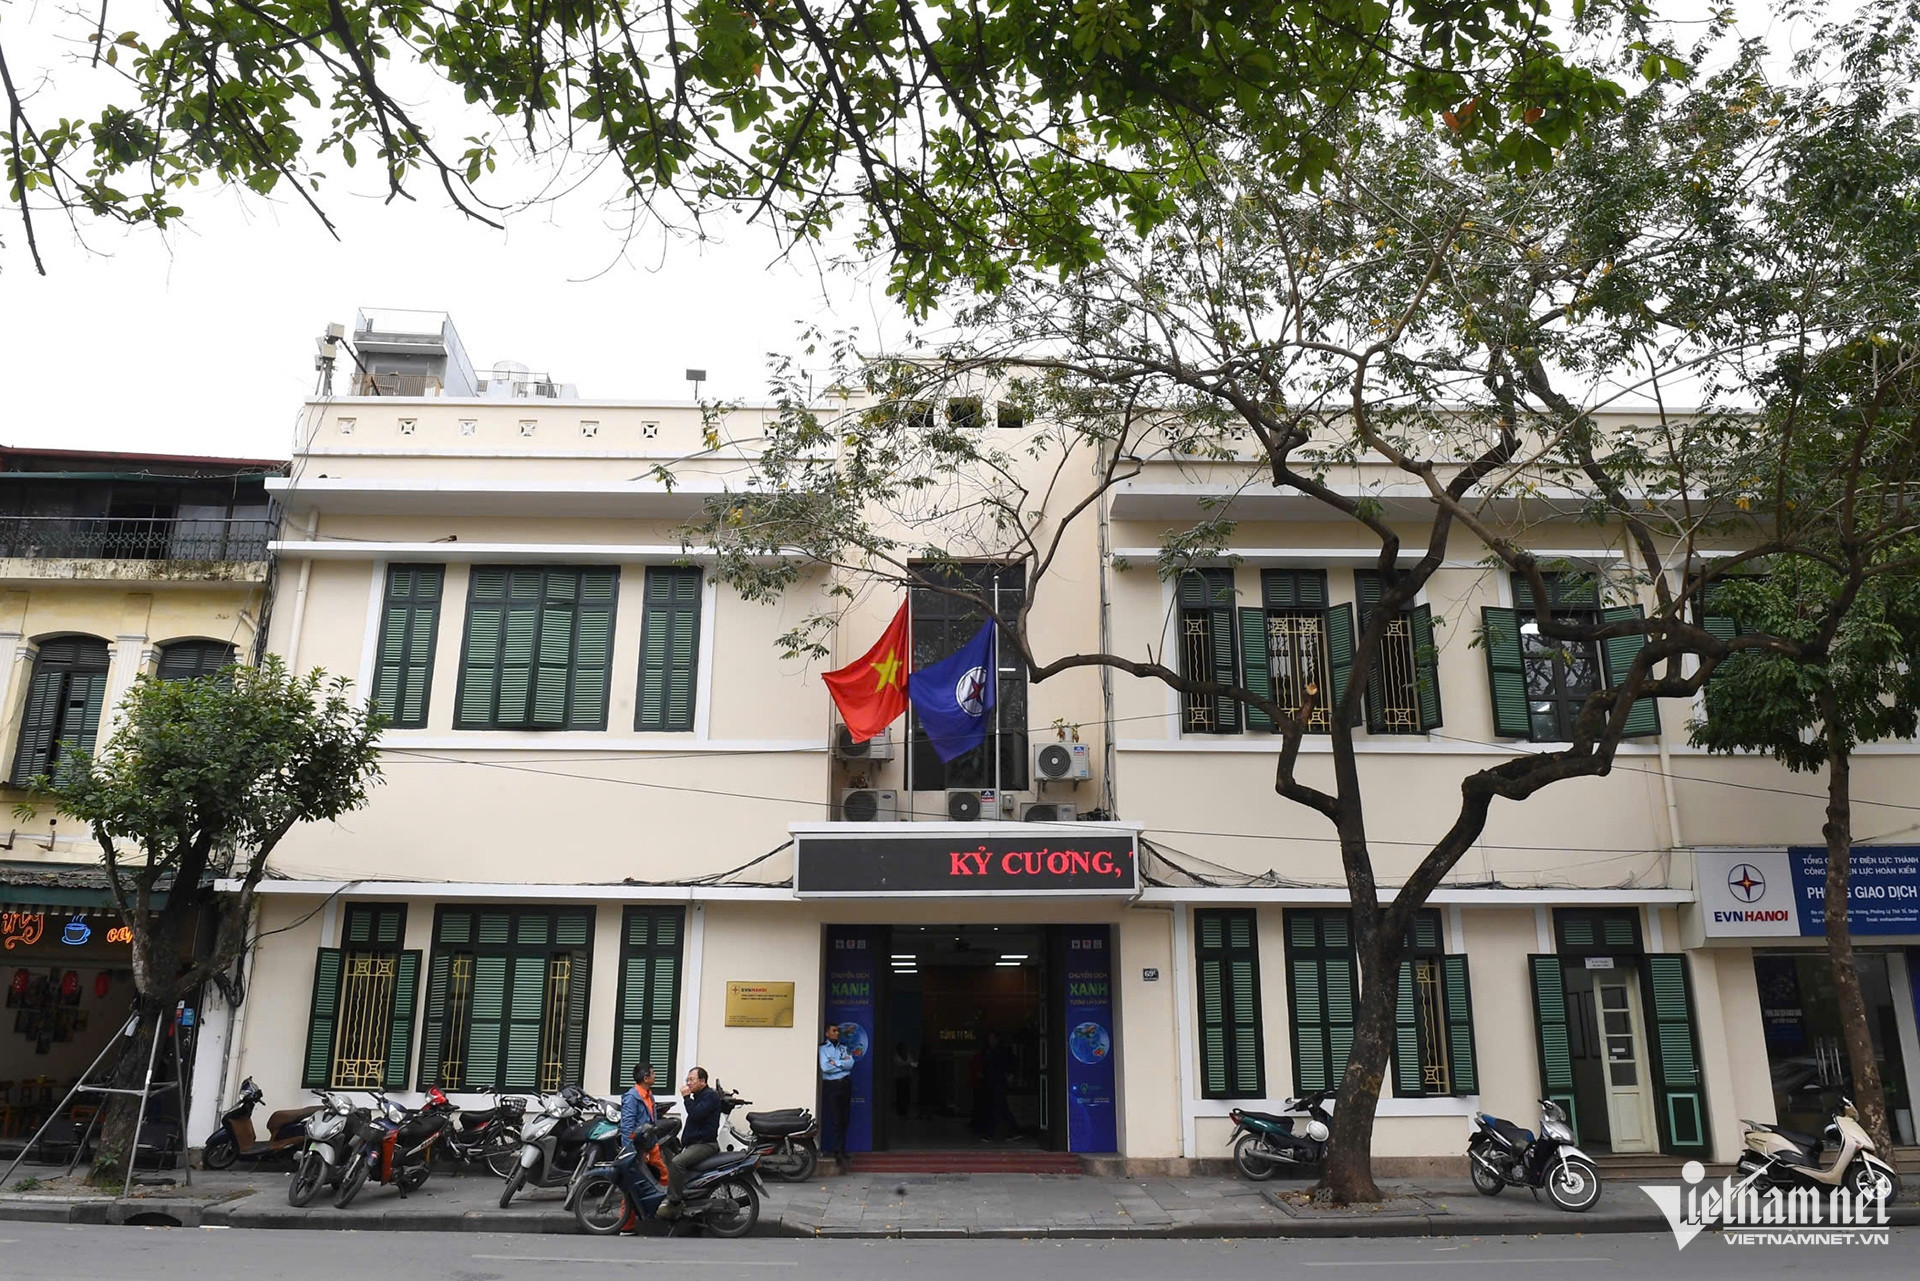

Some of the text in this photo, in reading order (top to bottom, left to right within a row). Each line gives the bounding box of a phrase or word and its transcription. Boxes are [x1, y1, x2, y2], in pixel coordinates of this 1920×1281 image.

[949, 845, 1122, 878] KỶ CƯƠNG,
[1860, 855, 1877, 865] ĐIỆN
[1894, 855, 1919, 864] THÀNH
[1806, 885, 1918, 900] PHG GIAO DỊCH
[1714, 910, 1789, 923] EVNHANOI
[831, 982, 870, 996] XANH
[1069, 983, 1108, 996] XANH
